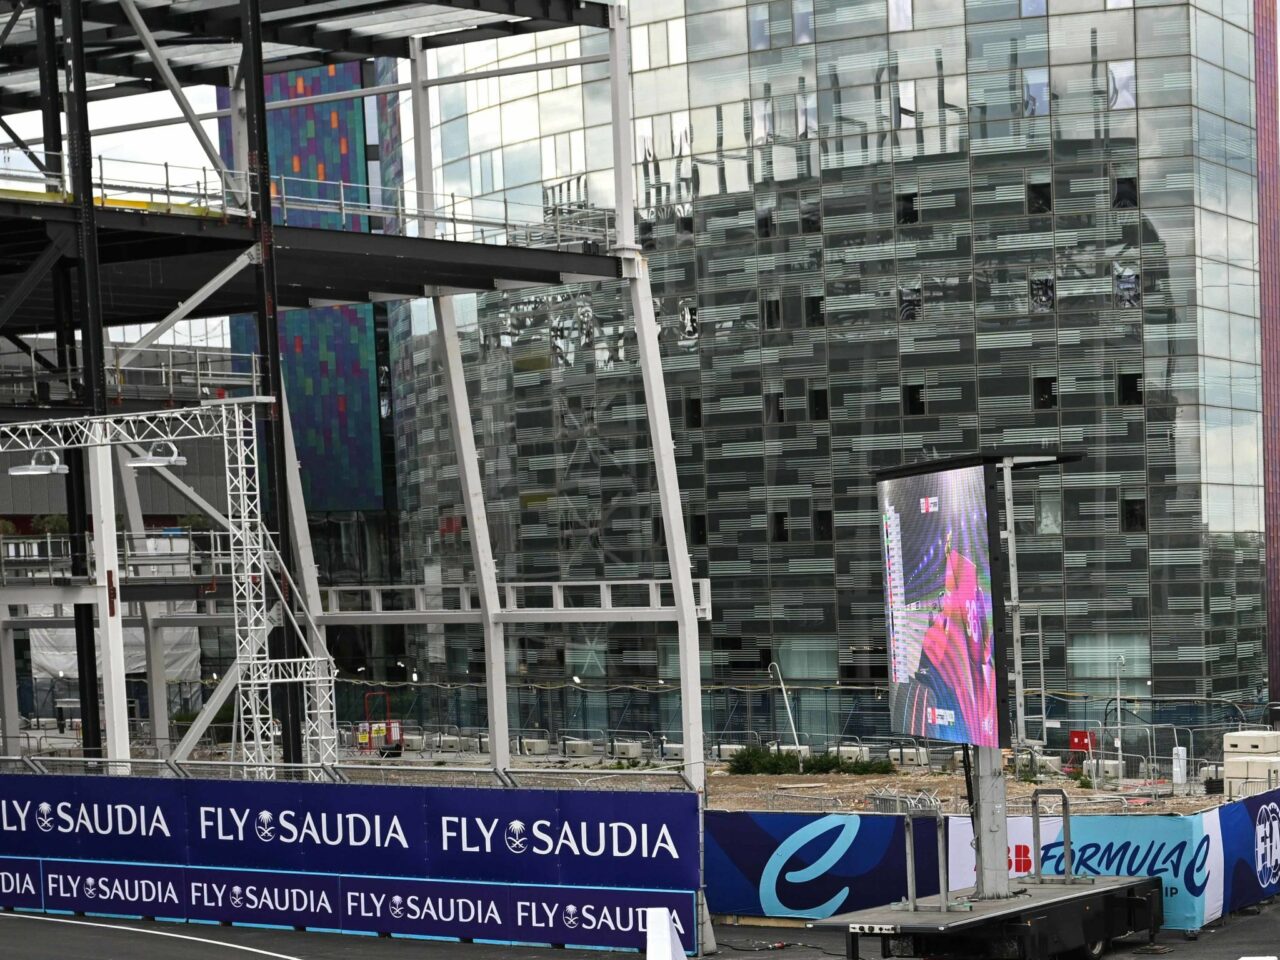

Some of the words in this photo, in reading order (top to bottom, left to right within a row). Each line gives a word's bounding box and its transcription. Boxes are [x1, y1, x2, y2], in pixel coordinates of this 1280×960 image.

[56, 801, 171, 837] SAUDIA
[200, 806, 250, 841] FLY
[278, 810, 408, 848] SAUDIA
[441, 816, 499, 852] FLY
[532, 819, 680, 859] SAUDIA
[48, 874, 81, 898] FLY
[98, 877, 179, 904] SAUDIA
[191, 882, 227, 907] FLY
[245, 885, 333, 914] SAUDIA
[347, 891, 386, 917] FLY
[406, 895, 502, 925] SAUDIA
[517, 901, 559, 928] FLY
[581, 904, 685, 934] SAUDA
